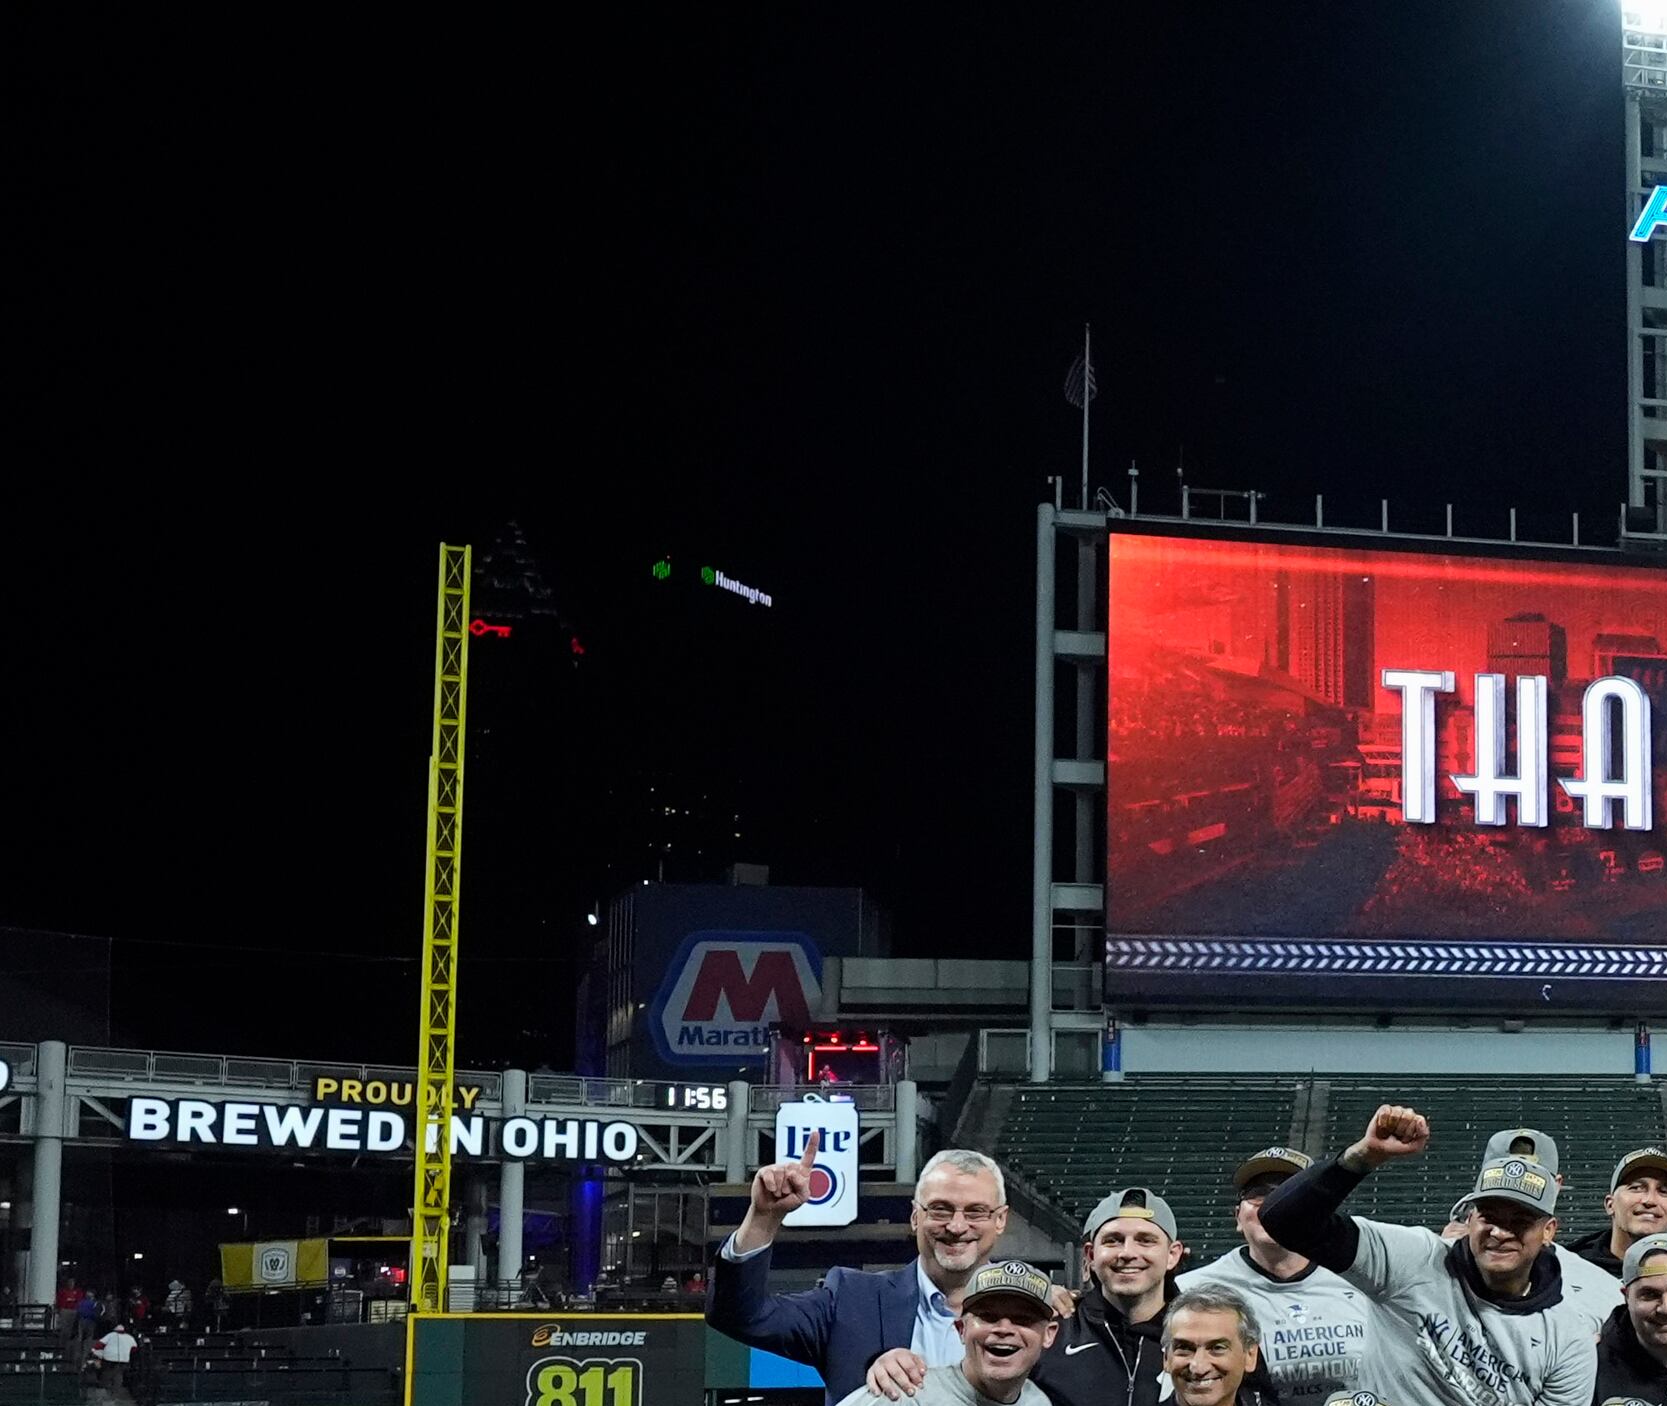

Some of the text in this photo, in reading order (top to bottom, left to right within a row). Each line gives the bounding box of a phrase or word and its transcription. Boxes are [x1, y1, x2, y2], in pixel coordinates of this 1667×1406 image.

[715, 569, 772, 608] Huntington
[677, 1025, 772, 1047] Marat
[667, 1086, 728, 1110] 11:56
[129, 1097, 406, 1152] BREWED
[502, 1117, 639, 1162] OHIO
[549, 1330, 648, 1347] ENBRIDGE
[1273, 1323, 1364, 1345] AMERICAN
[1274, 1340, 1346, 1362] LEAGUE
